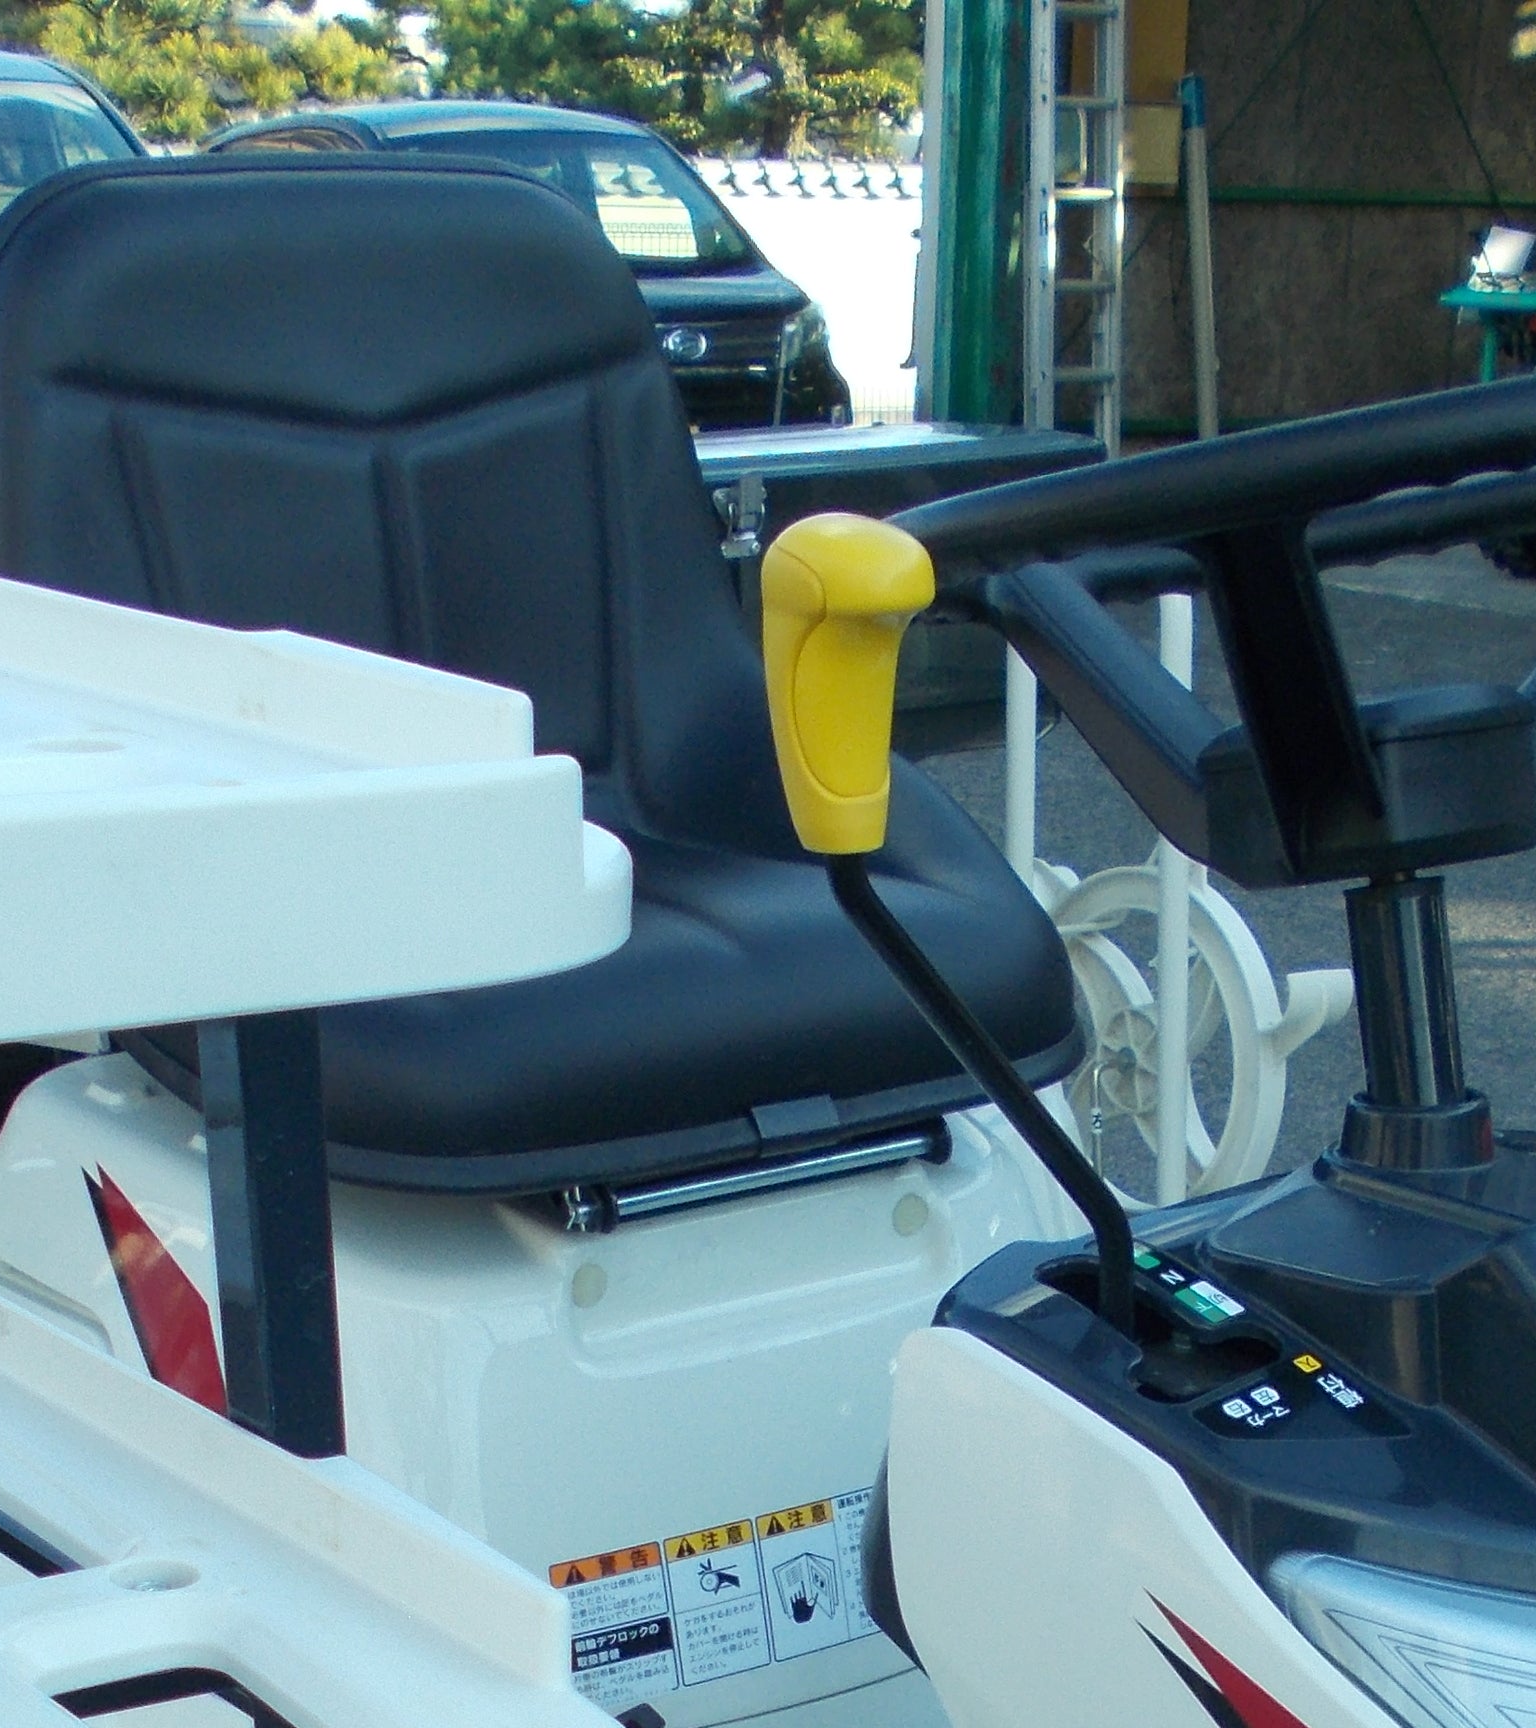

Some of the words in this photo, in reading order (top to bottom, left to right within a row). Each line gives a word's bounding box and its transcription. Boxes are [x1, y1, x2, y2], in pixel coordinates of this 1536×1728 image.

[1160, 1269, 1185, 1285] N
[1195, 1301, 1212, 1314] 下
[1297, 1357, 1317, 1368] 入
[1254, 1389, 1273, 1402] 左
[1317, 1373, 1364, 1409] 植付
[1227, 1402, 1246, 1415] 右
[1246, 1405, 1291, 1427] マーカ
[787, 1503, 828, 1530] 注意
[701, 1525, 745, 1551] 注意
